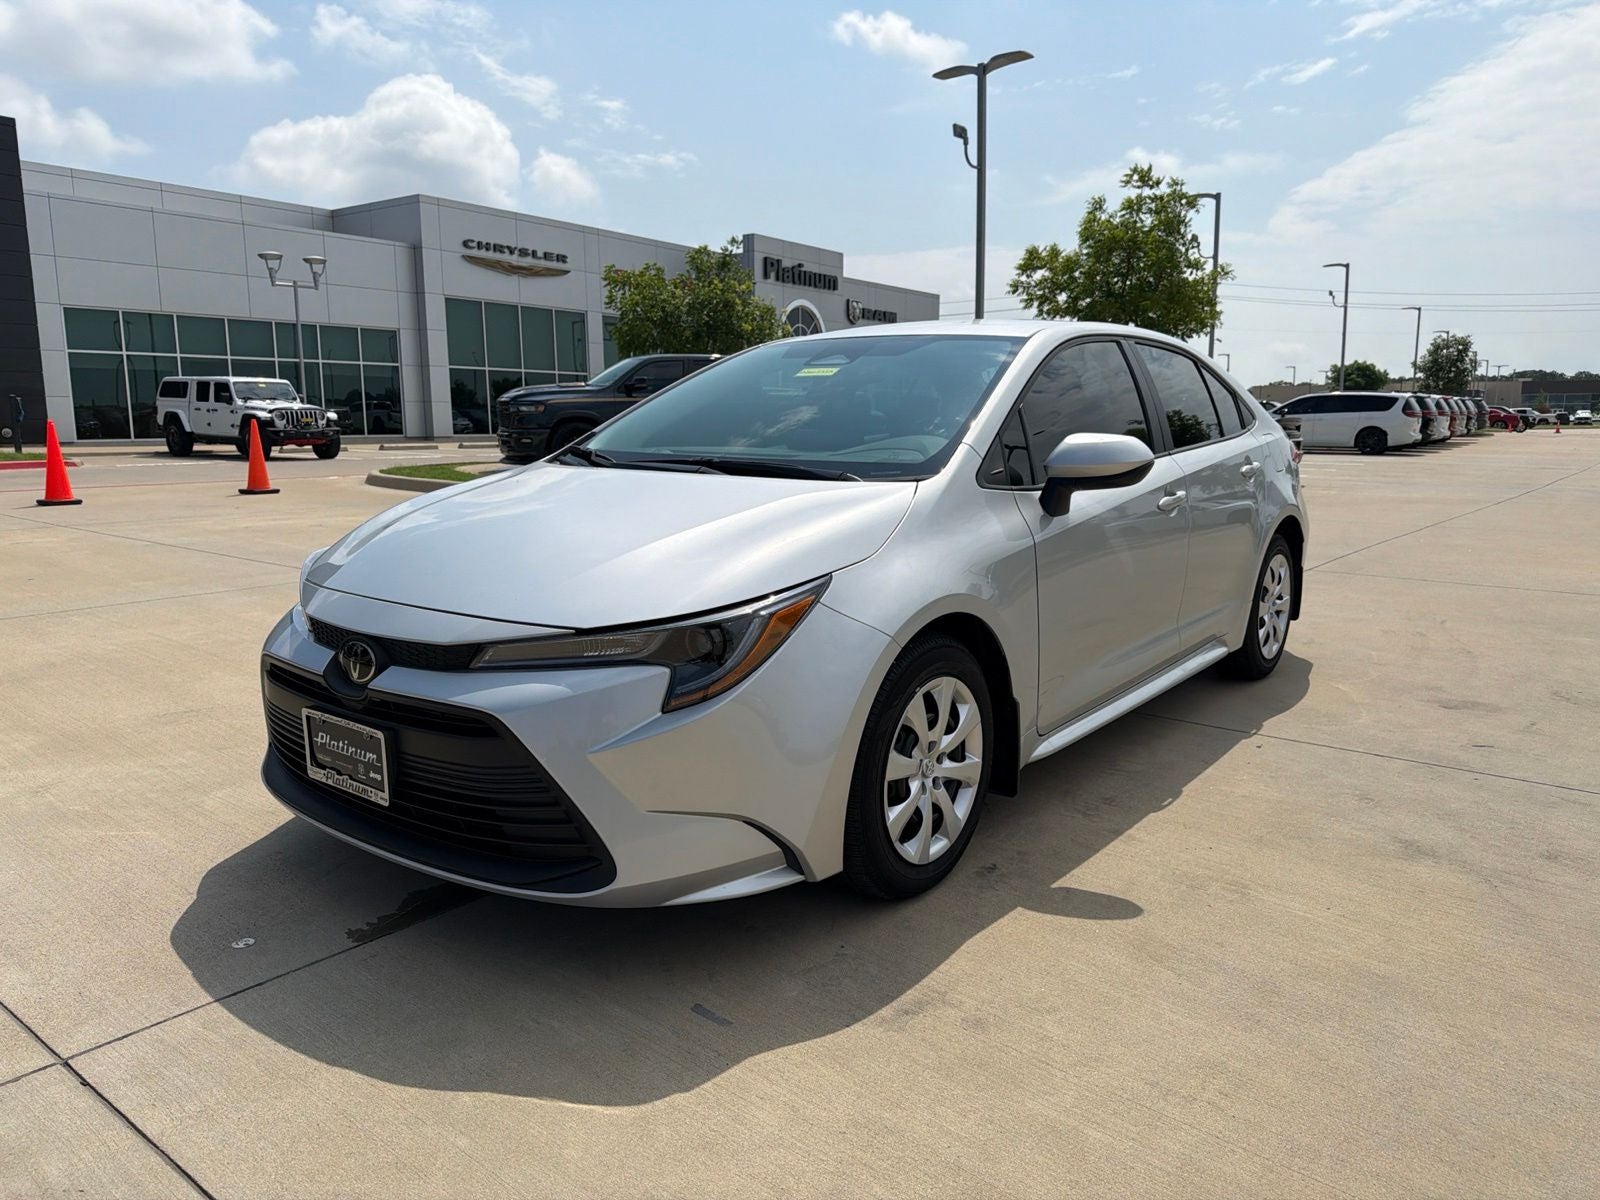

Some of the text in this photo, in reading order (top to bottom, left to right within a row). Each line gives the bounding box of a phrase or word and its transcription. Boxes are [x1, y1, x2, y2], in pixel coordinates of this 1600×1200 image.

[462, 239, 568, 264] CHRYSLER
[763, 256, 838, 291] Platinum
[862, 307, 897, 323] RAM
[314, 732, 381, 766] Platinum
[323, 771, 372, 798] Platinum
